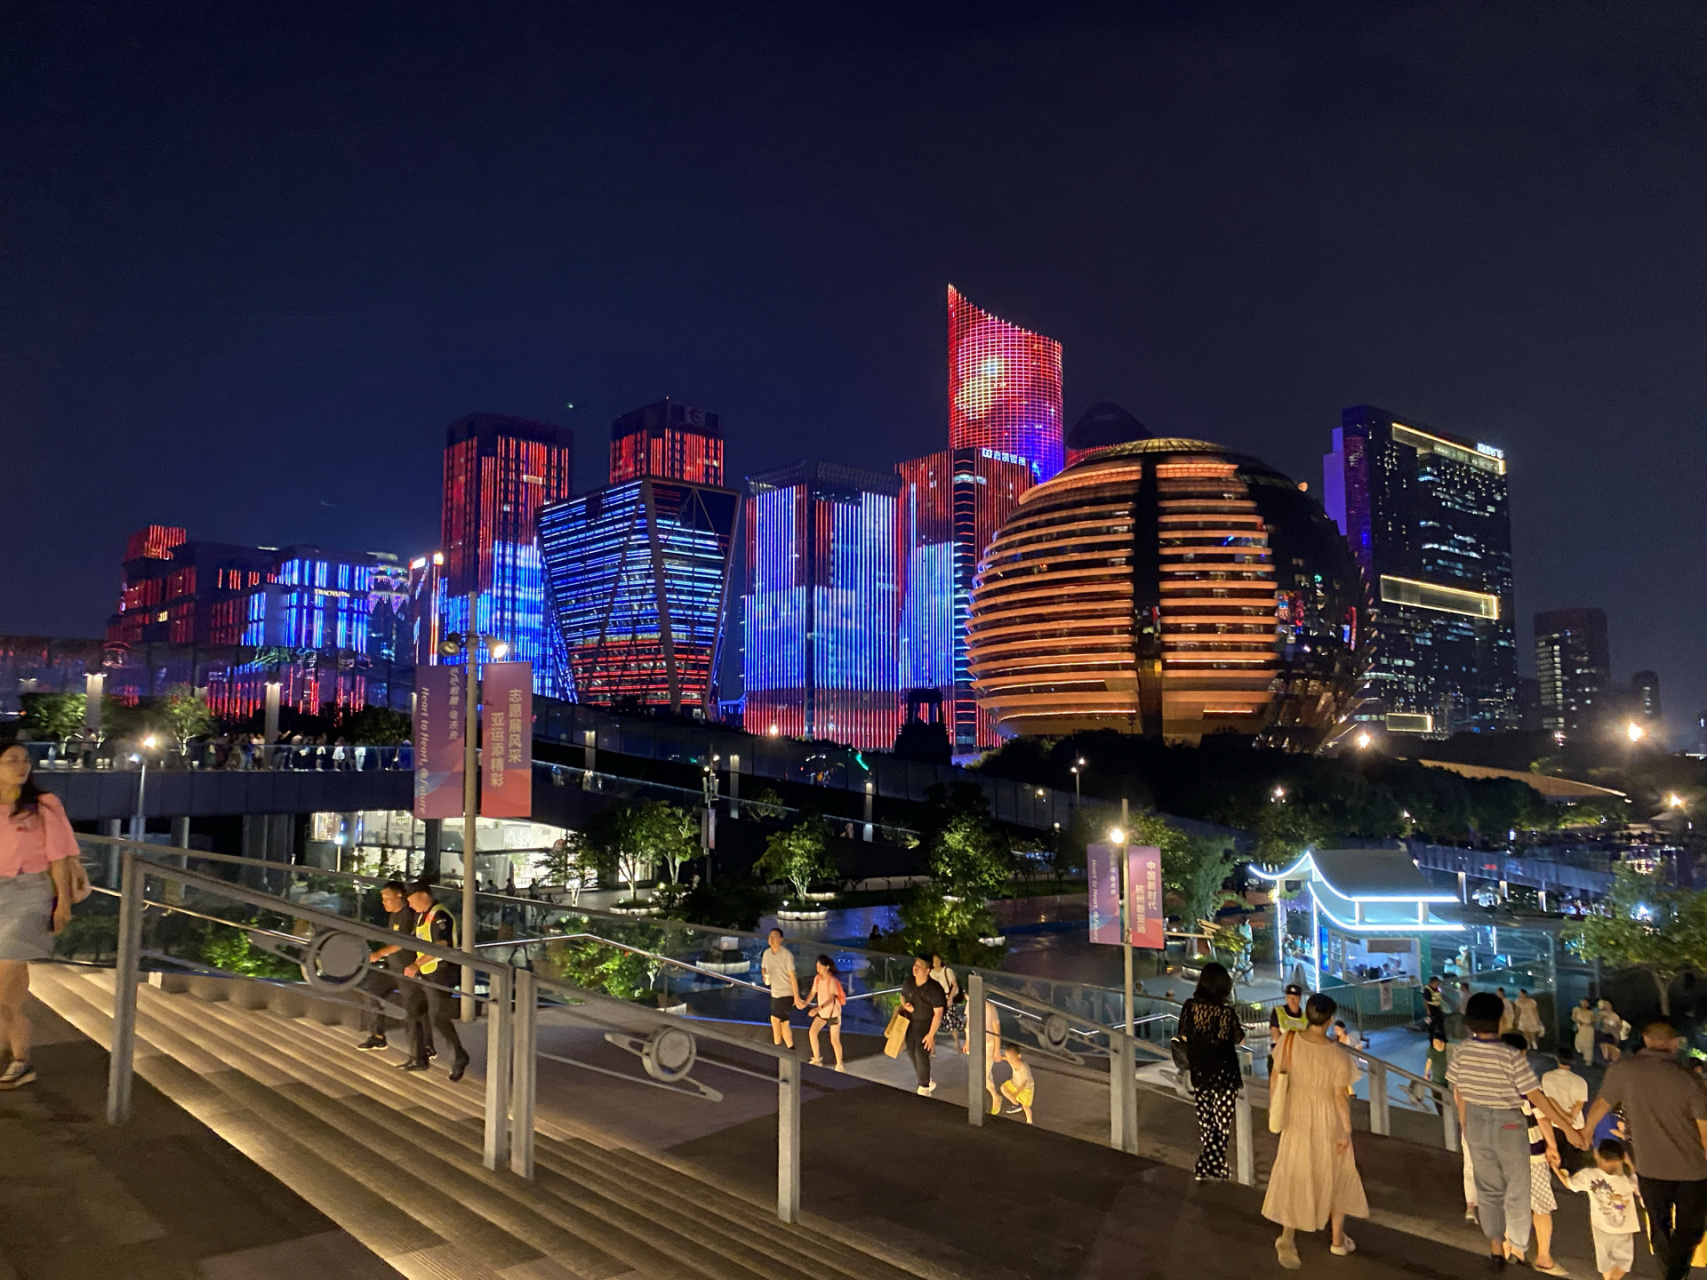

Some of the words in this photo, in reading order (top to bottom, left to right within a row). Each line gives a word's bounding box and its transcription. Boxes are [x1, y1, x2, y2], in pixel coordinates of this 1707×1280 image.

[420, 687, 430, 717] Heart
[420, 720, 429, 731] to
[508, 688, 523, 764] 志愿展风采
[419, 732, 430, 766] Heart,
[490, 712, 504, 787] 亚运添精彩
[419, 767, 429, 815] @Future
[1146, 861, 1158, 911] 中国新时代
